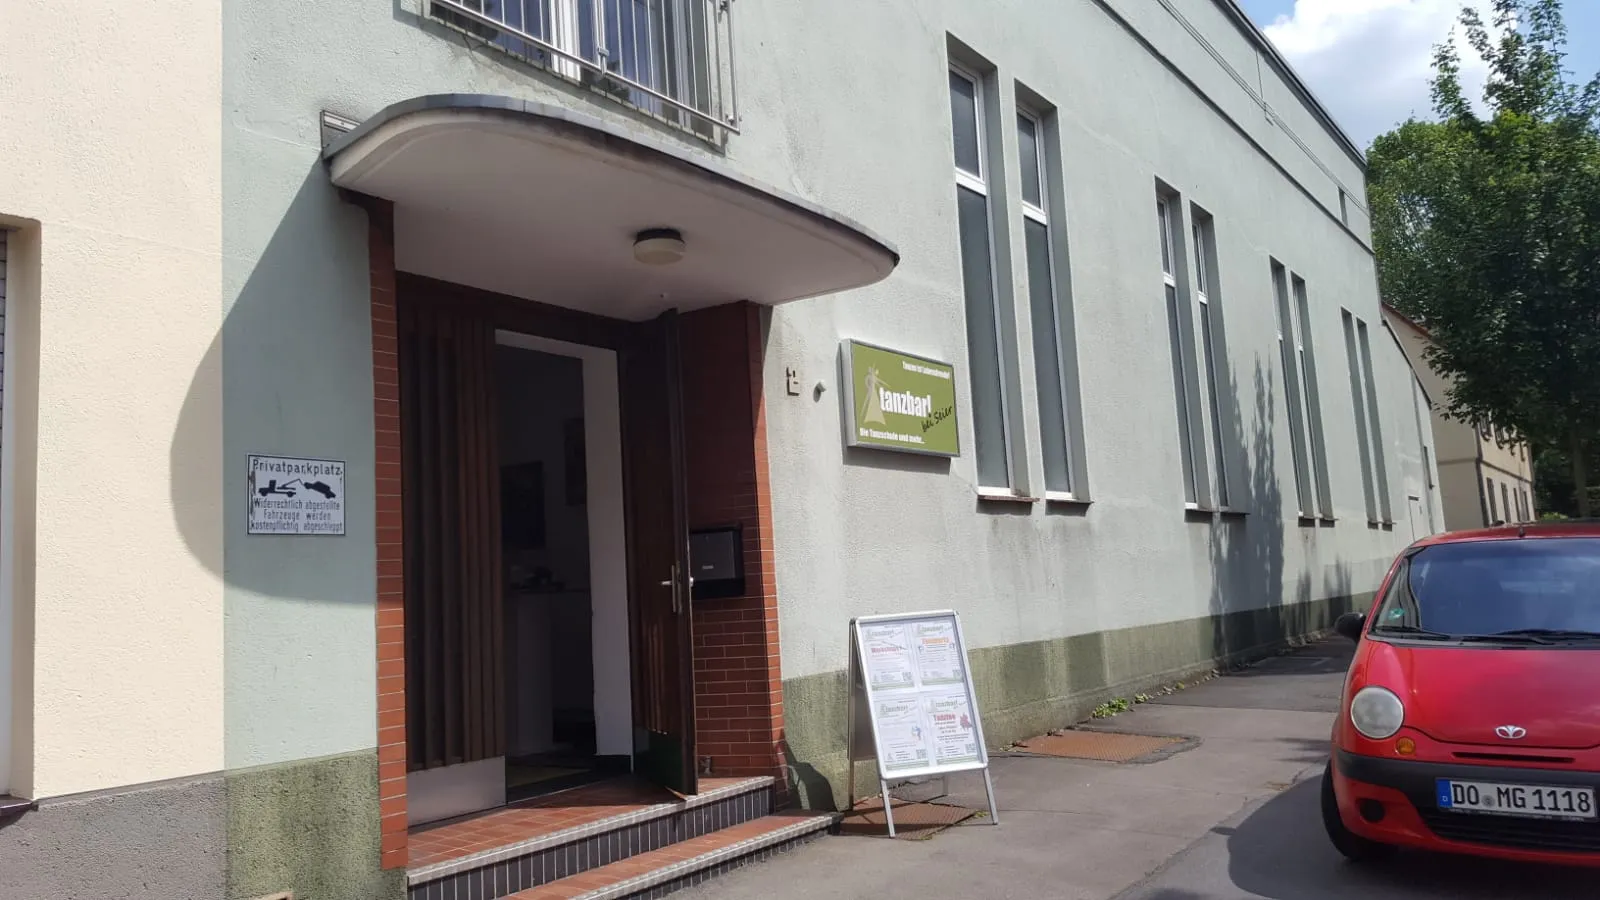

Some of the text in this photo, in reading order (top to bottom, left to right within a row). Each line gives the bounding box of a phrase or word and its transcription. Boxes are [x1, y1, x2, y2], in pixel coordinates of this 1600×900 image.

[879, 387, 931, 417] tanzbar!
[859, 427, 869, 437] Die
[869, 429, 898, 440] Tanzschule
[899, 433, 909, 442] und
[253, 459, 341, 476] Privatparkplatz
[254, 498, 340, 512] Widerrechtlich abgestellte
[264, 509, 331, 521] Fahrzeuge werden
[250, 520, 343, 533] kostenpflichtig abgeschleppt
[1452, 783, 1591, 813] DO MG 1118
